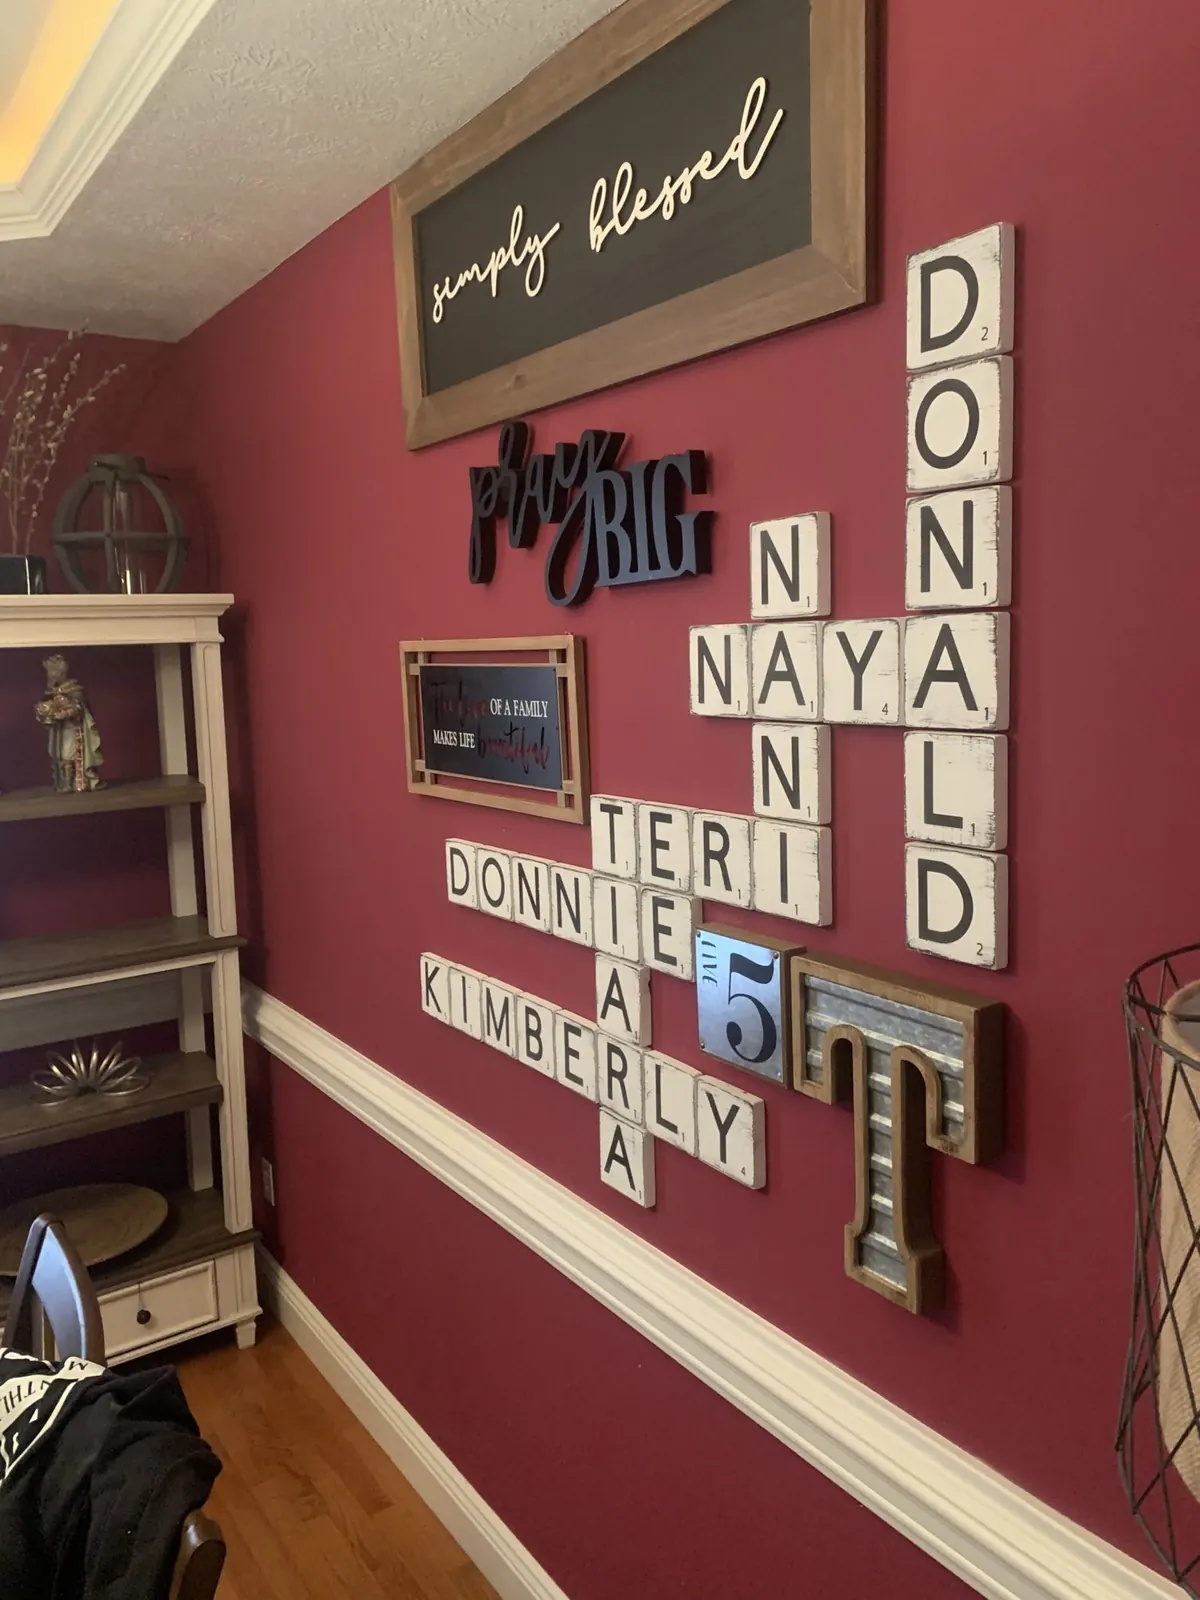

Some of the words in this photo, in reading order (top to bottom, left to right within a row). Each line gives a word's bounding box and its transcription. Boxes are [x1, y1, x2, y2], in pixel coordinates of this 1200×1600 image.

[432, 204, 560, 324] simply
[588, 76, 784, 253] blessed
[981, 327, 989, 341] 2
[982, 451, 989, 466] 1
[594, 450, 705, 588] BIG
[982, 582, 989, 597] 1
[490, 698, 502, 715] OF
[504, 700, 512, 716] A
[514, 700, 549, 718] FAMILY
[881, 703, 889, 716] 4
[433, 729, 458, 746] MAKES
[459, 732, 476, 748] LIFE
[976, 943, 984, 957] 2
[701, 939, 718, 987] FIVE
[726, 952, 777, 1063] 5
[425, 961, 740, 1164] KIMBERLY
[791, 955, 980, 1314] T
